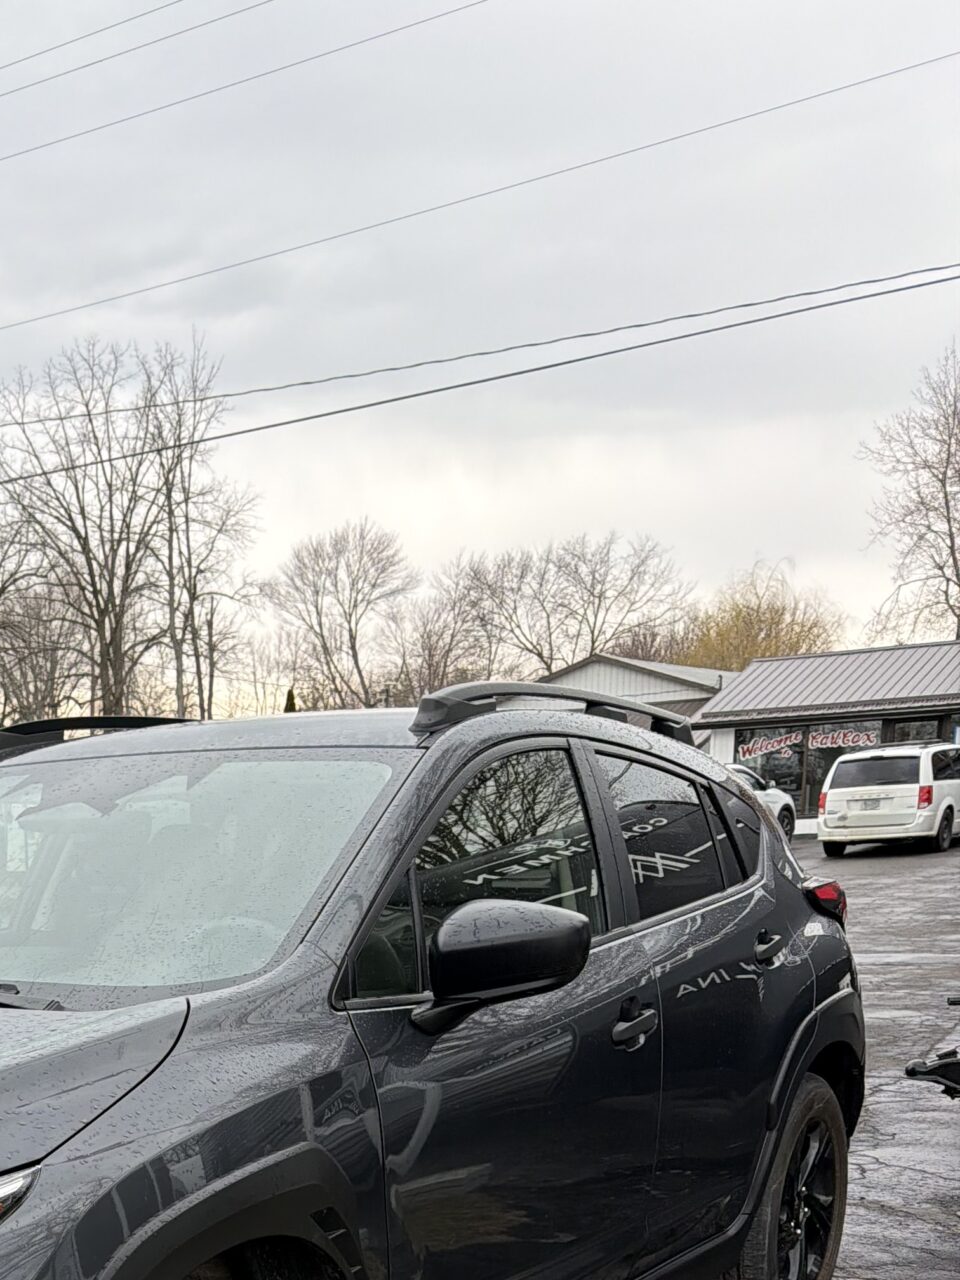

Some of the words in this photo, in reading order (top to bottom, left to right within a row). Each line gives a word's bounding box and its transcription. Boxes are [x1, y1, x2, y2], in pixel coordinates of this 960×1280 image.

[738, 731, 803, 760] Welcome
[809, 730, 842, 749] Carl
[841, 729, 876, 746] Cox
